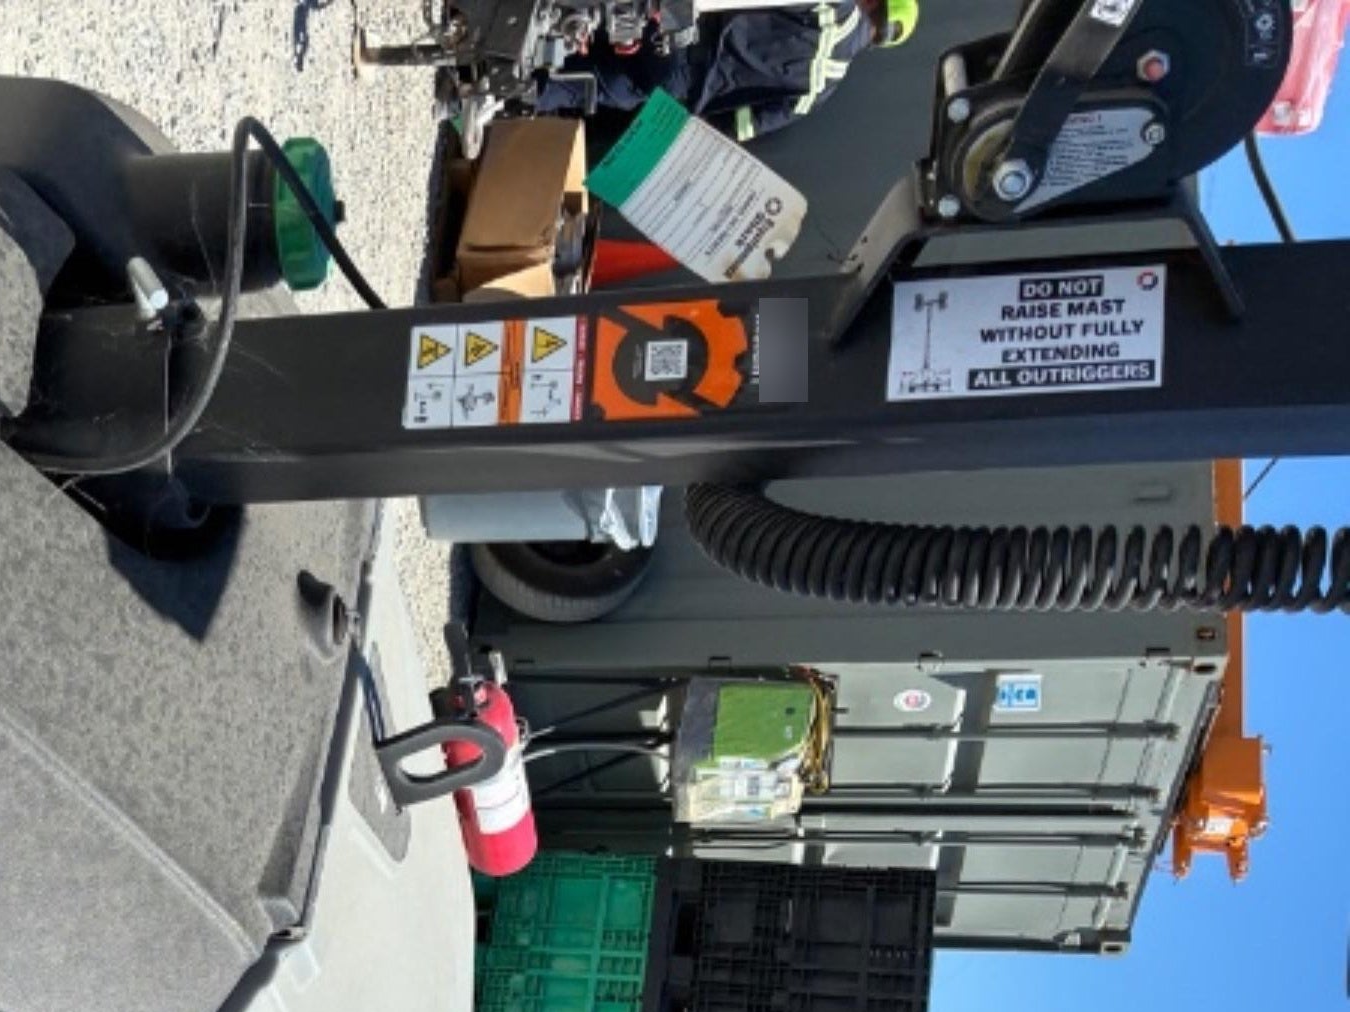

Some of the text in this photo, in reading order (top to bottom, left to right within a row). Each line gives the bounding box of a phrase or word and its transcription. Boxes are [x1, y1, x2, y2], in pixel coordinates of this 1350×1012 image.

[1022, 277, 1102, 298] DO NOT
[1001, 298, 1126, 321] RAISE MAST
[979, 319, 1145, 344] WITHOUT FULLY
[1001, 342, 1120, 364] EXTENDING
[973, 363, 1151, 388] ALL OUTRIGGERS
